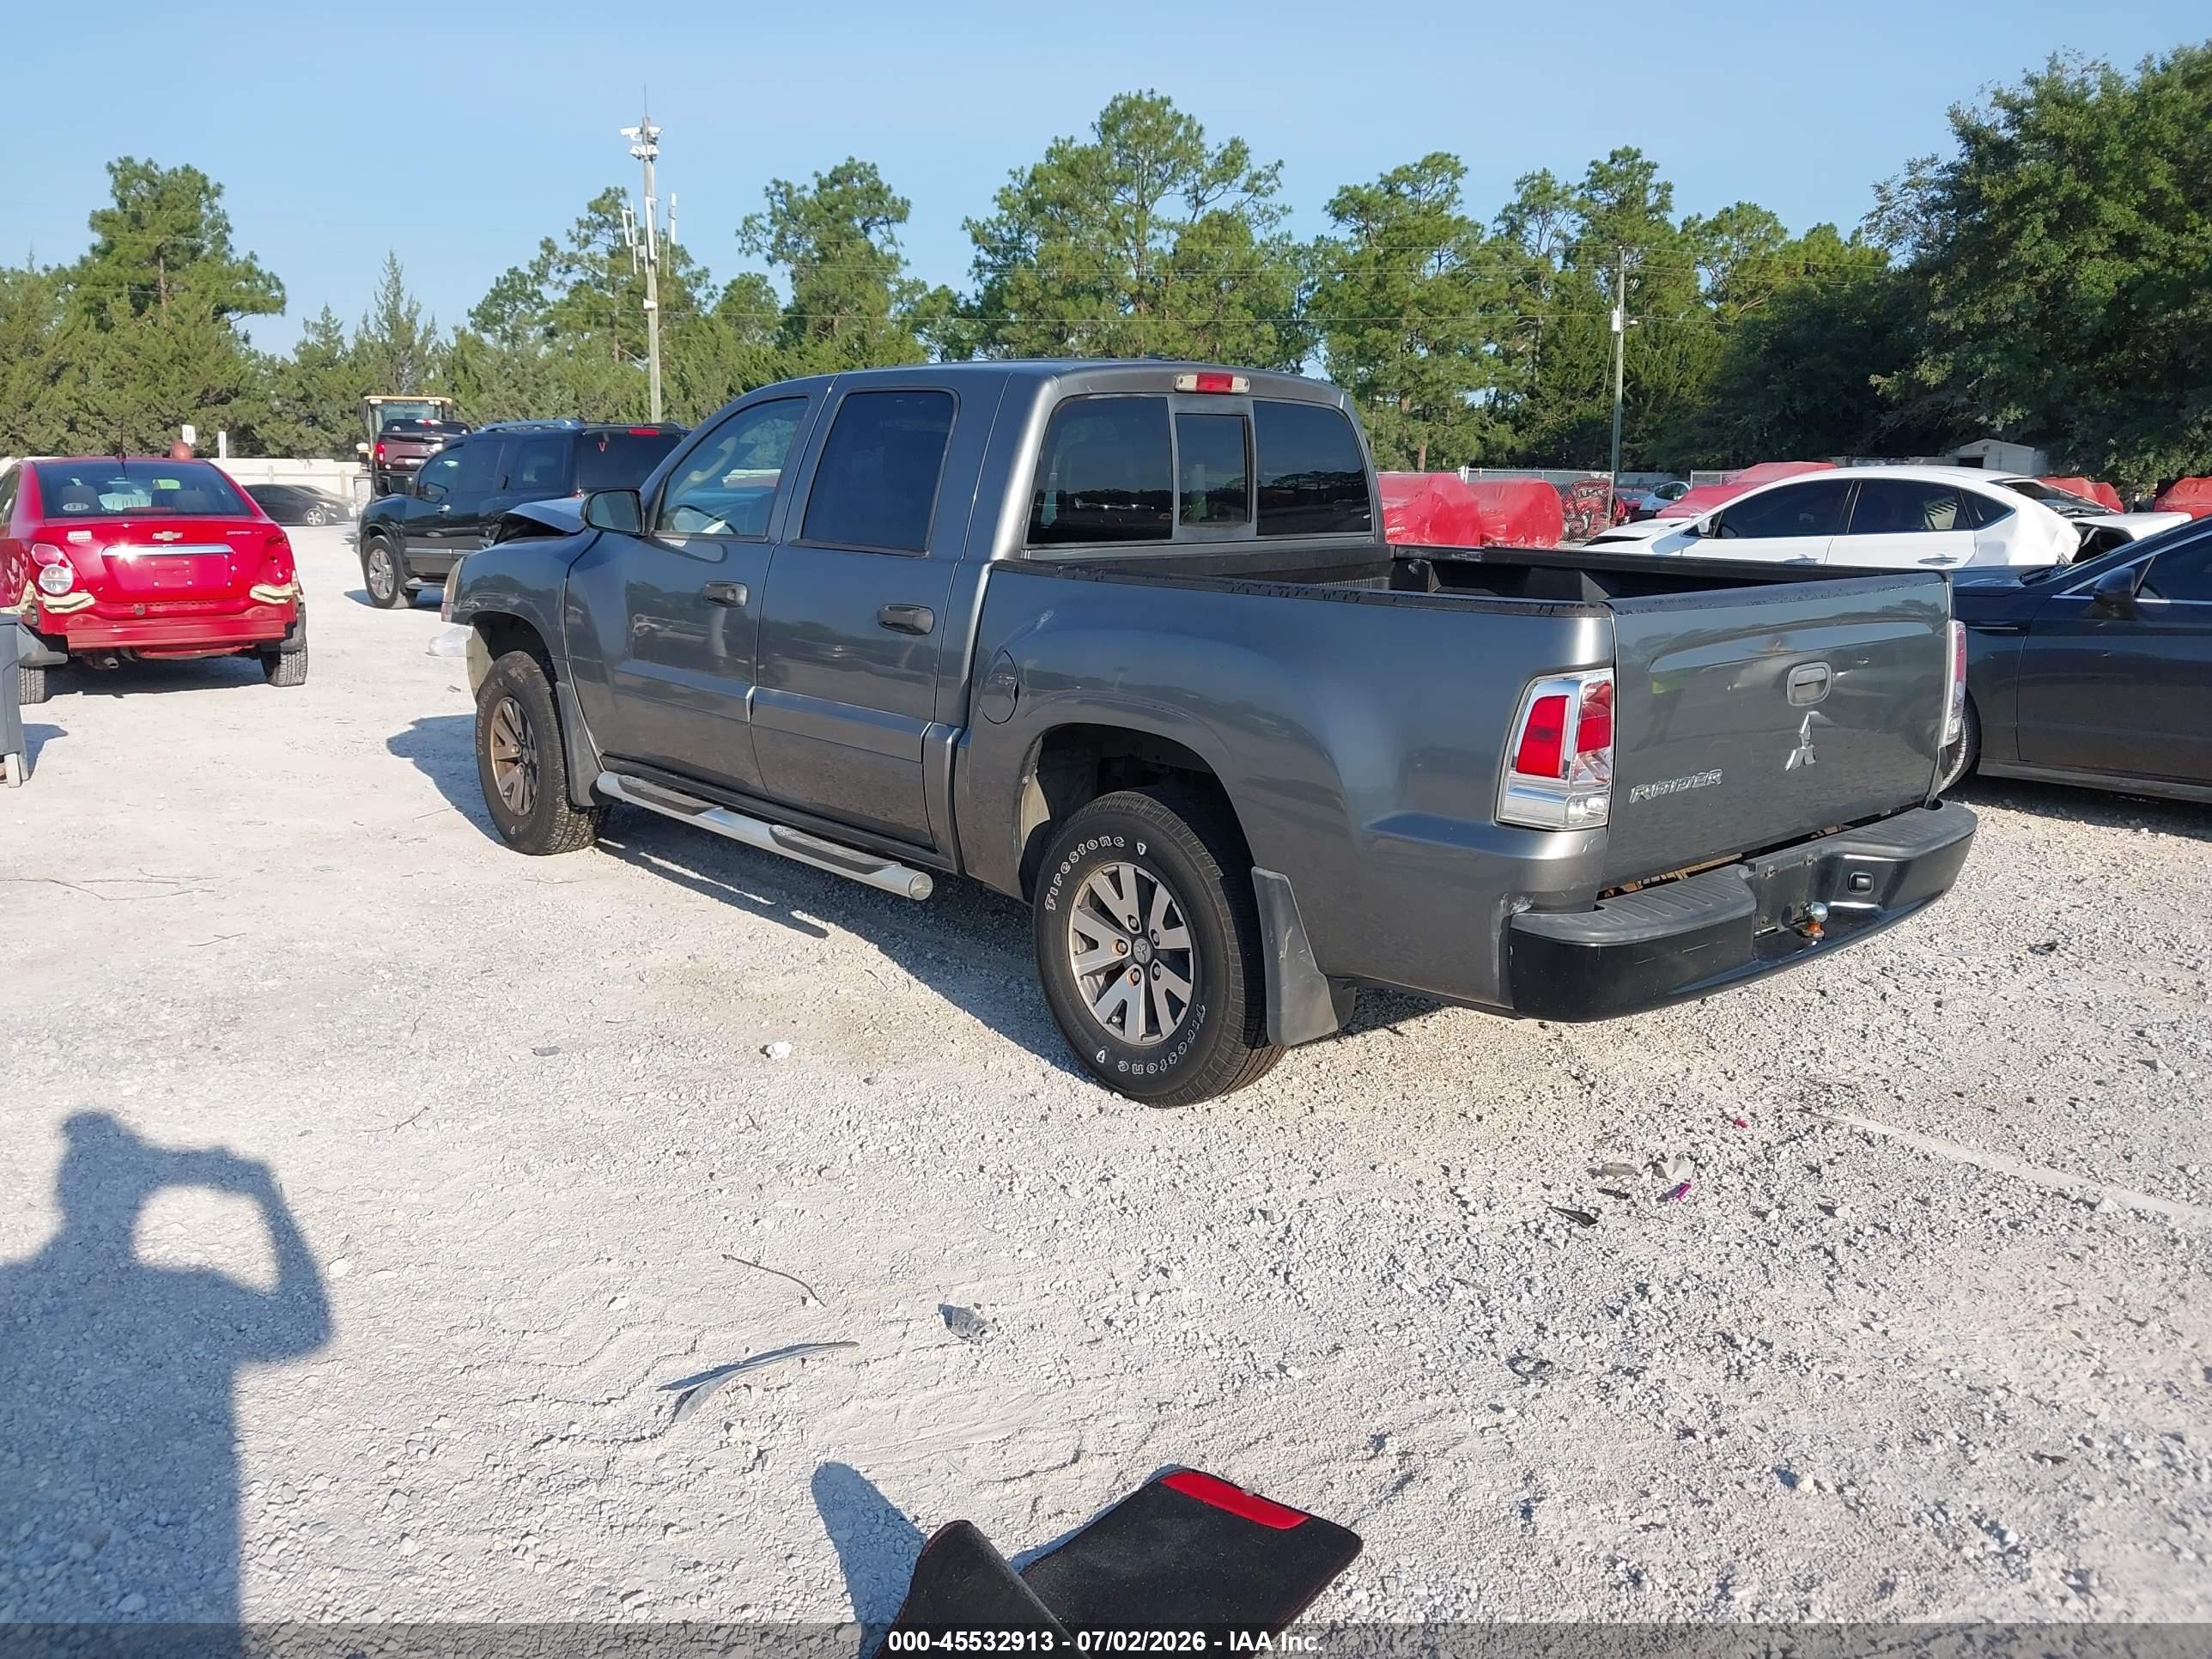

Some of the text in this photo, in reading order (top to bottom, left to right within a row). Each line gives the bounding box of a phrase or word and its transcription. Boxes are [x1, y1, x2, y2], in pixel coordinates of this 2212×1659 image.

[1629, 769, 1723, 804] RAIDER
[1044, 836, 1126, 911] Firestone
[1116, 1003, 1206, 1075] Firestone
